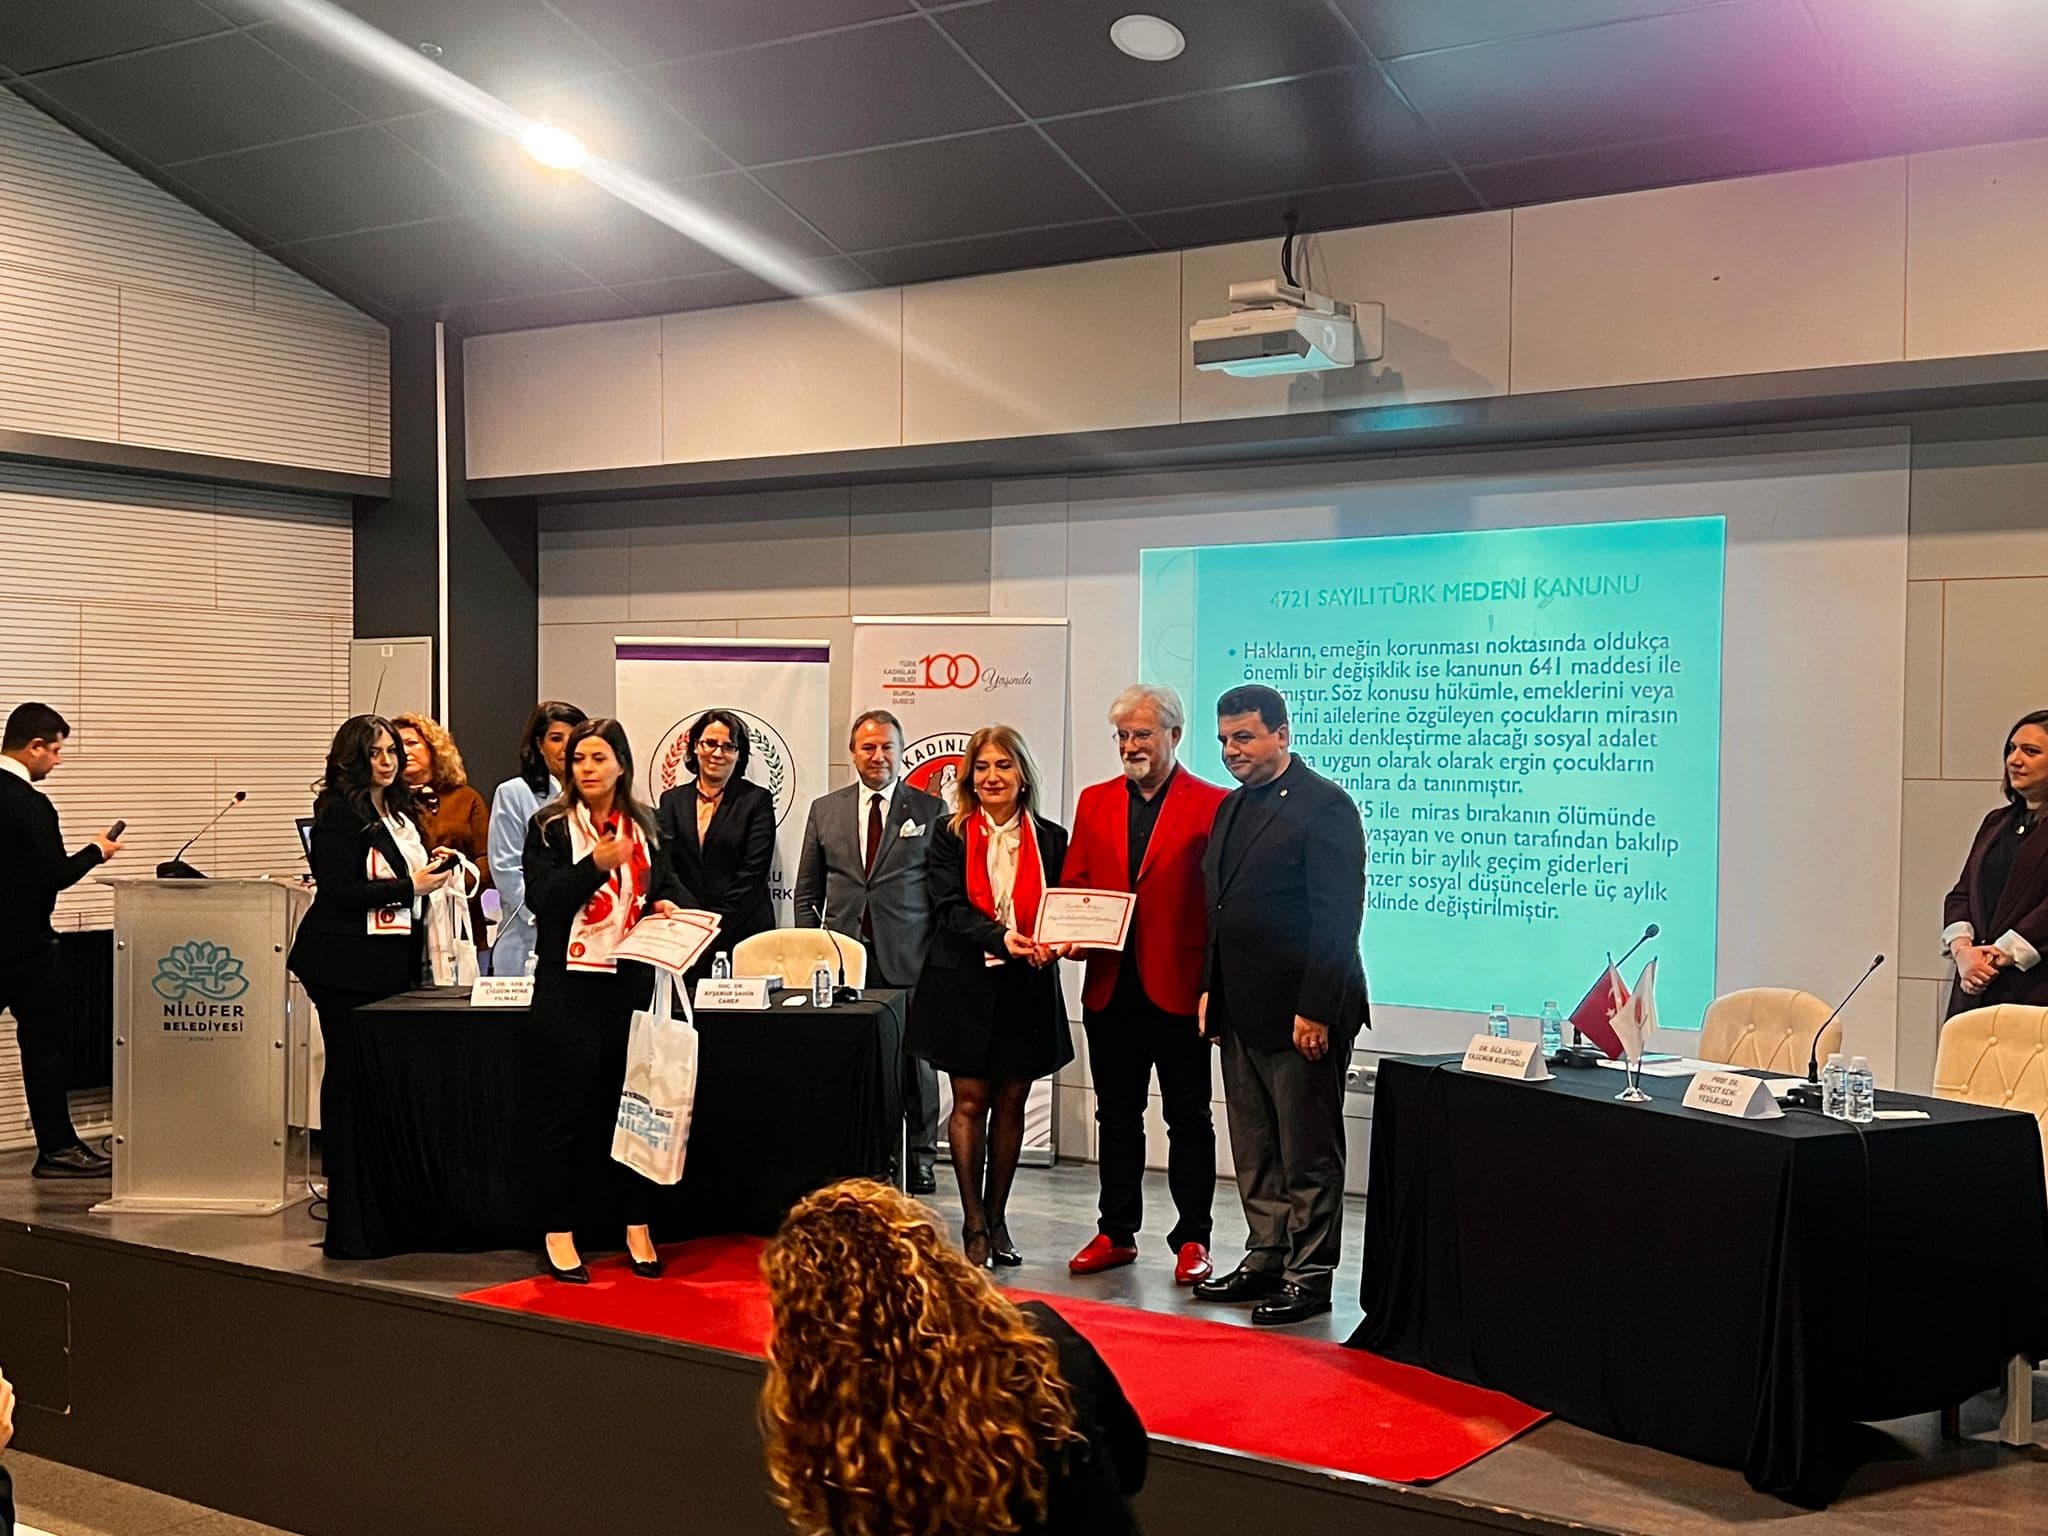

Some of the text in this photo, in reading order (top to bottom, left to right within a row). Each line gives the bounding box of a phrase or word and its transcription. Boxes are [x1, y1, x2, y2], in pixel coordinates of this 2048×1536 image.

[1443, 577, 1527, 603] MEDENİ
[1534, 574, 1640, 598] KANUNU
[1244, 631, 1670, 661] Hakların, emeğin korunması noktasında oldukça
[919, 654, 980, 689] 100
[981, 667, 1032, 693] Yaşında
[1244, 654, 1681, 684] önemli bir değişiklik ise kanunun 641 maddesi ile
[1332, 684, 1362, 702] Söz
[1368, 683, 1429, 701] konusu
[1436, 681, 1518, 702] hükümle,
[1523, 680, 1624, 700] emeklerini
[1631, 685, 1674, 704] veya
[1324, 706, 1400, 724] ailelerine
[1407, 706, 1494, 729] özgüleyen
[1501, 704, 1598, 728] çocukların
[1606, 705, 1678, 724] mirasın
[1349, 728, 1462, 751] denkleştirme
[1468, 728, 1528, 751] alacağı
[1534, 728, 1591, 752] sosyal
[1599, 728, 1658, 748] adalet
[1322, 755, 1371, 773] uygun
[1377, 751, 1431, 769] olarak
[1437, 751, 1493, 770] olarak
[1500, 753, 1546, 775] ergin
[1553, 752, 1654, 775] çocukların
[1397, 773, 1416, 791] da
[1424, 776, 1523, 799] tanınmıştır.
[1380, 801, 1400, 819] ile
[1411, 804, 1460, 821] miras
[1467, 804, 1550, 824] bırakanın
[1558, 805, 1656, 827] ölümünde
[1434, 830, 1454, 843] ve
[1461, 831, 1507, 846] onun
[1514, 828, 1608, 850] tarafından
[1616, 831, 1679, 858] bakılıp
[1412, 848, 1436, 866] bir
[1442, 849, 1482, 872] aylık
[1487, 853, 1541, 874] geçim
[1548, 854, 1629, 877] giderleri
[1409, 872, 1462, 895] sosyal
[1469, 872, 1588, 899] düşüncelerle
[1595, 879, 1617, 902] üç
[1624, 881, 1668, 905] aylık
[1425, 895, 1559, 923] değiştirilmiştir.
[163, 1001, 245, 1017] NİLÜFER
[163, 1020, 243, 1032] BELEDİYESİ
